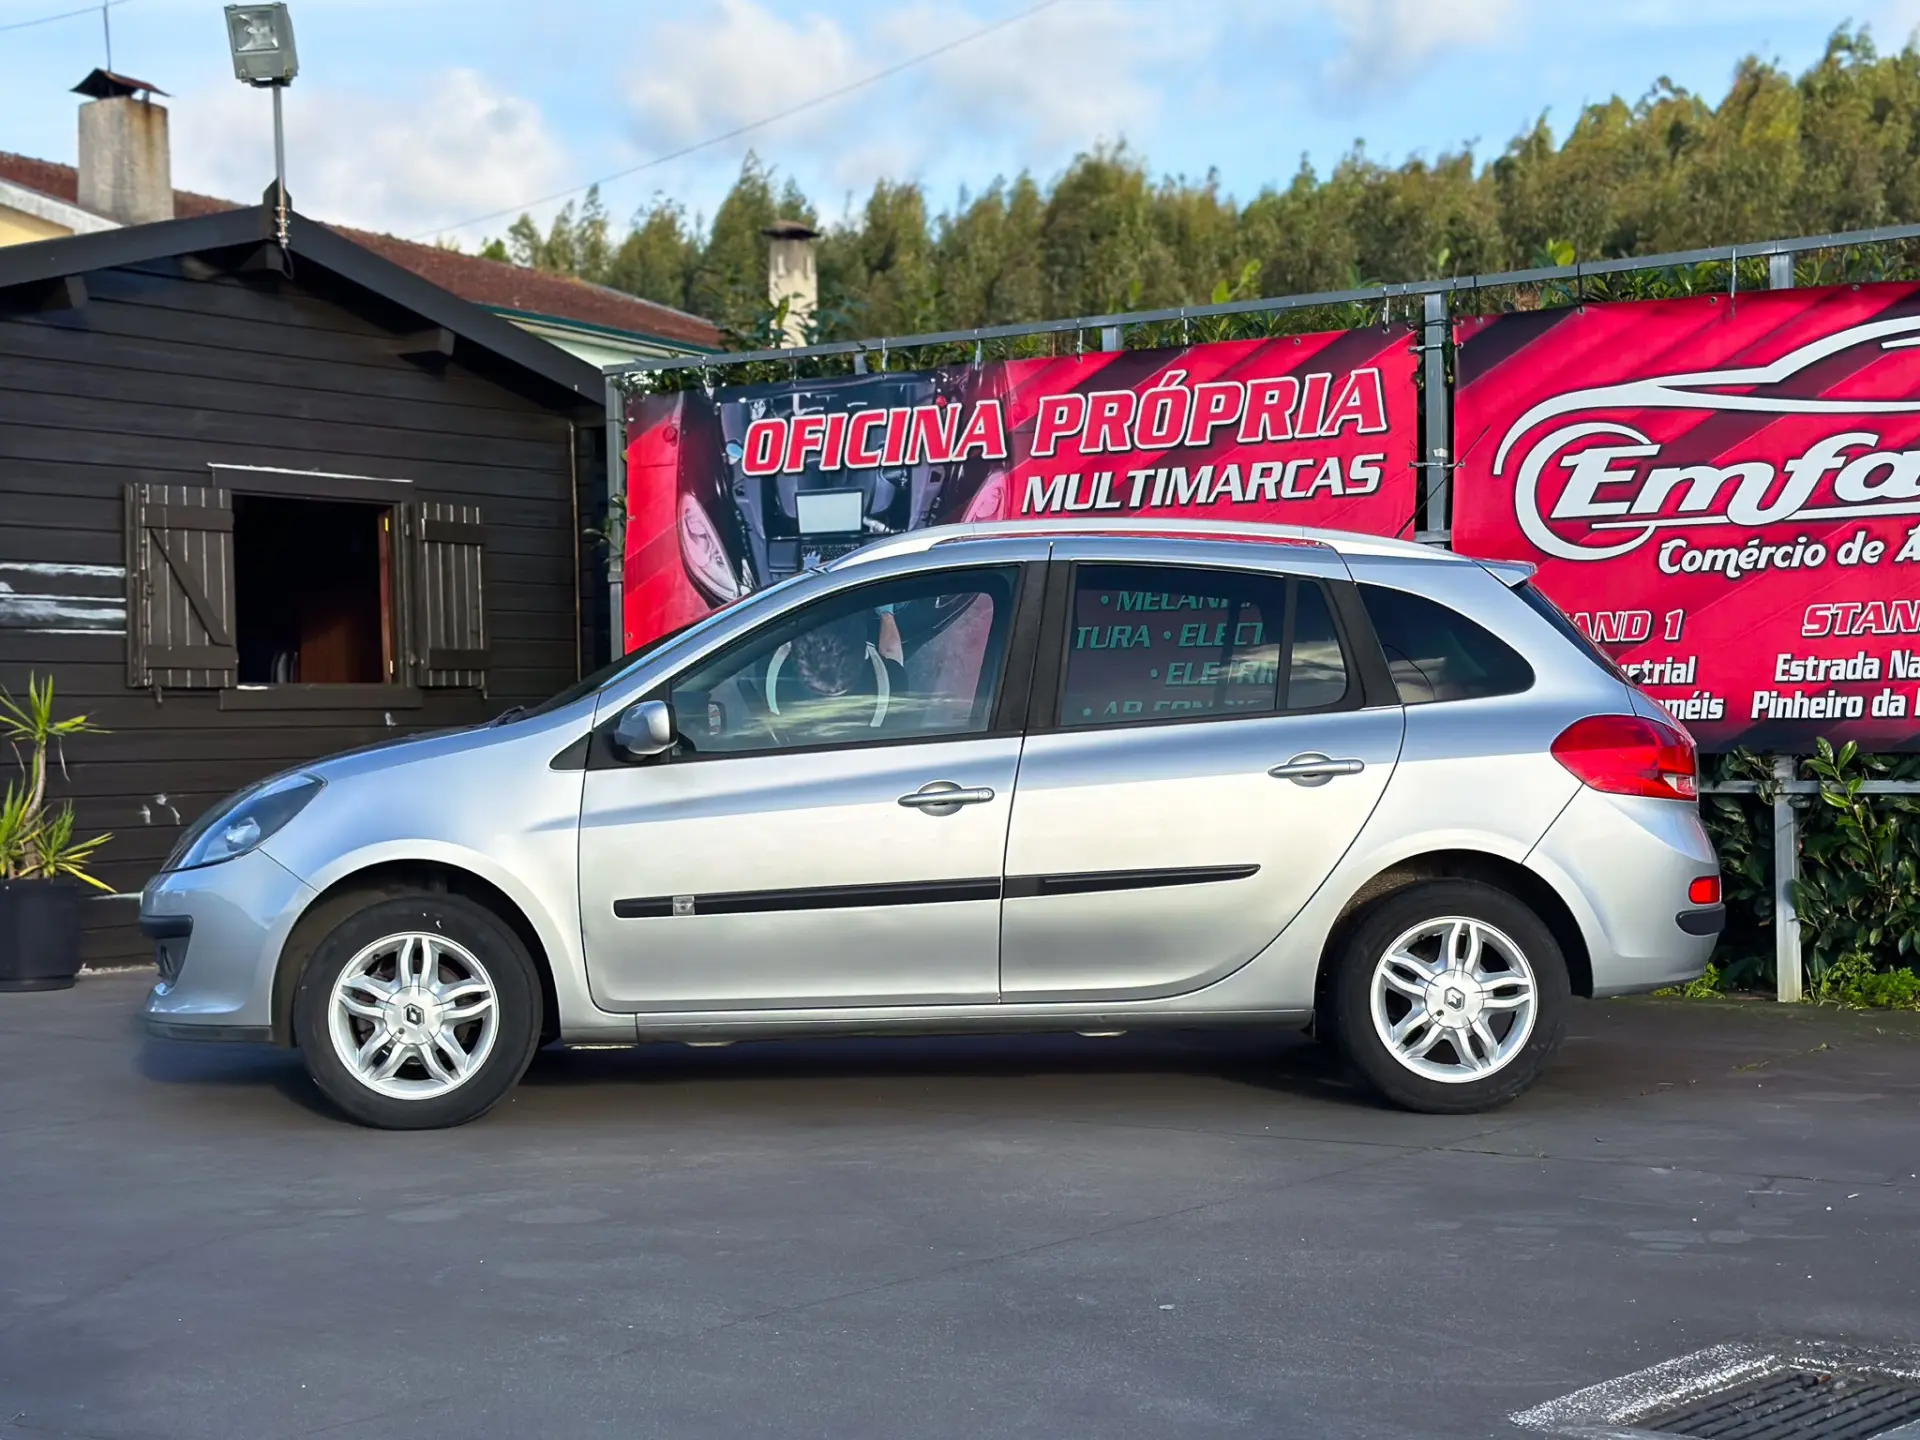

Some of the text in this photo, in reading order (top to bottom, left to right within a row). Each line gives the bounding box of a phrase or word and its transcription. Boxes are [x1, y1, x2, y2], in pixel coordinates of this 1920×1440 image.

[742, 367, 1388, 476] OFICINA PRÓPRIA
[1021, 452, 1384, 514] MULTIMARCAS
[1658, 537, 1826, 579] Comércio
[1836, 531, 1884, 565] de
[1076, 626, 1151, 650] TURA
[1573, 608, 1684, 643] AND 1
[1621, 655, 1697, 684] strial
[1774, 650, 1880, 682] Estrada
[1658, 690, 1724, 720] méis
[1750, 689, 1864, 720] Pinheiro
[1871, 687, 1906, 718] da
